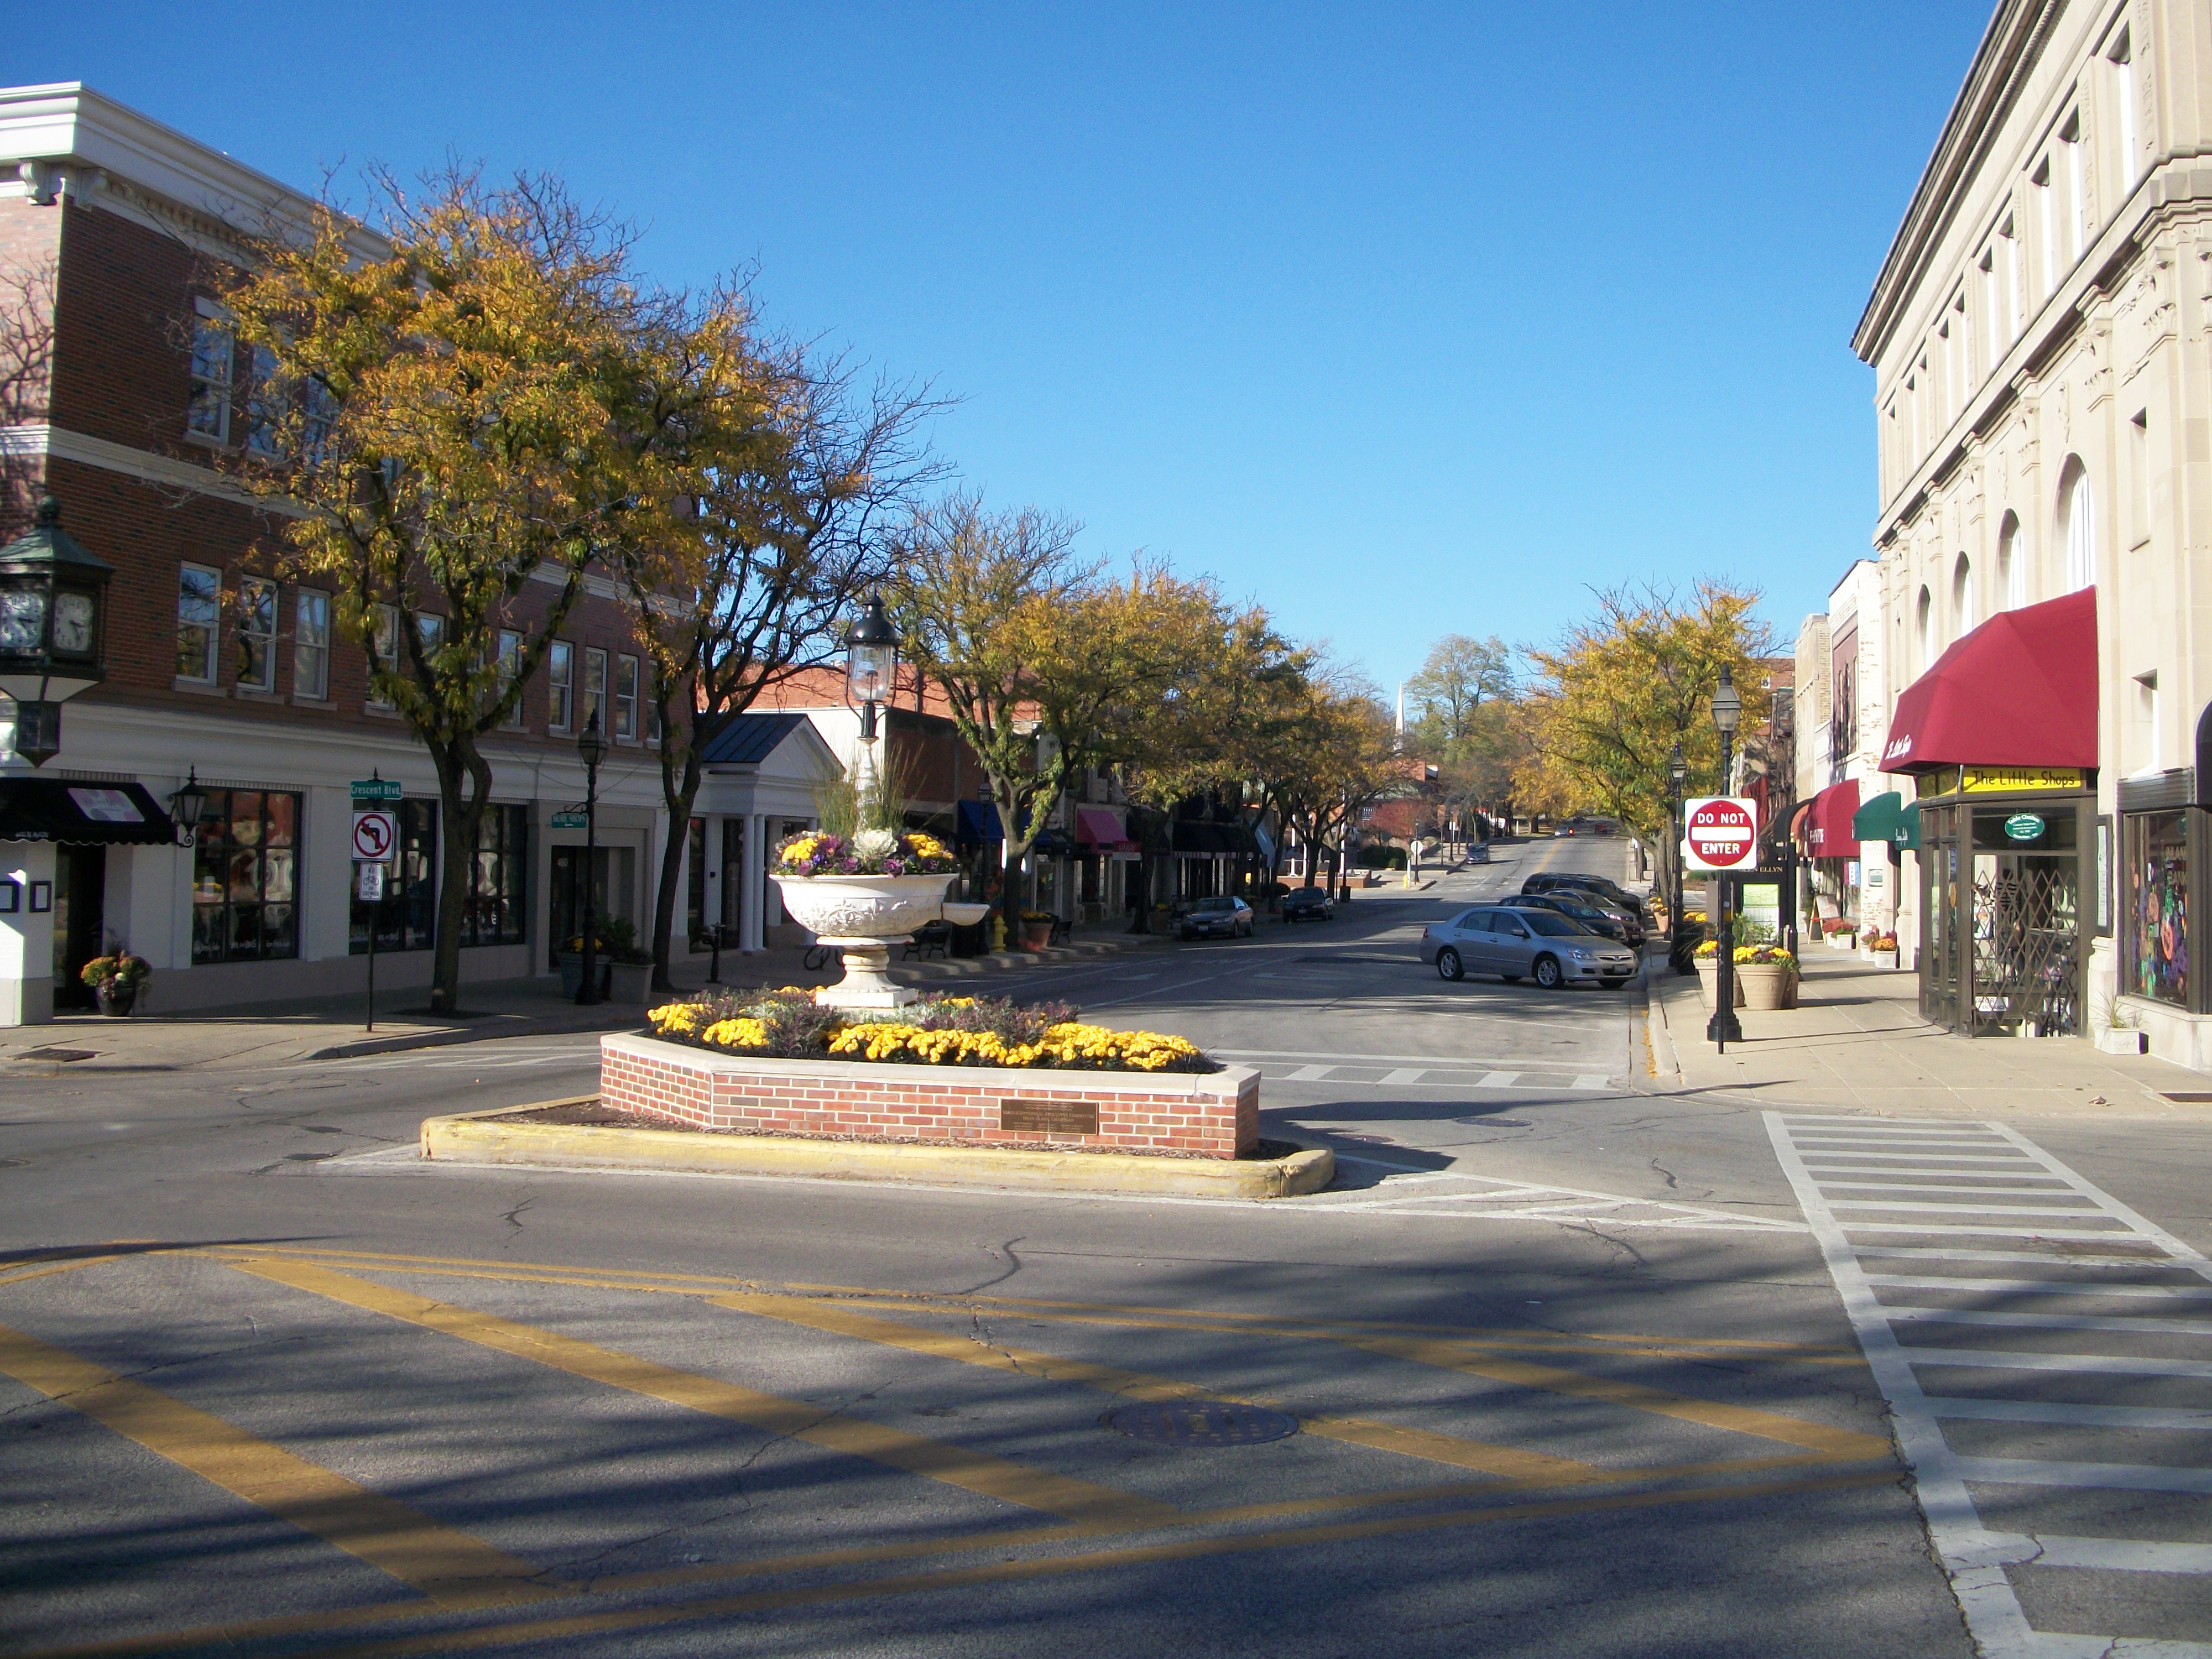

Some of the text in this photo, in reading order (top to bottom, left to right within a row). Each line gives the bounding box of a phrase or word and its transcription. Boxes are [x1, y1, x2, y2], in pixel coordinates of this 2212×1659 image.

[1972, 771, 2075, 787] The Little Shops
[351, 785, 382, 795] Crescent
[1697, 813, 1745, 824] DO NOT
[1702, 843, 1740, 854] ENTER
